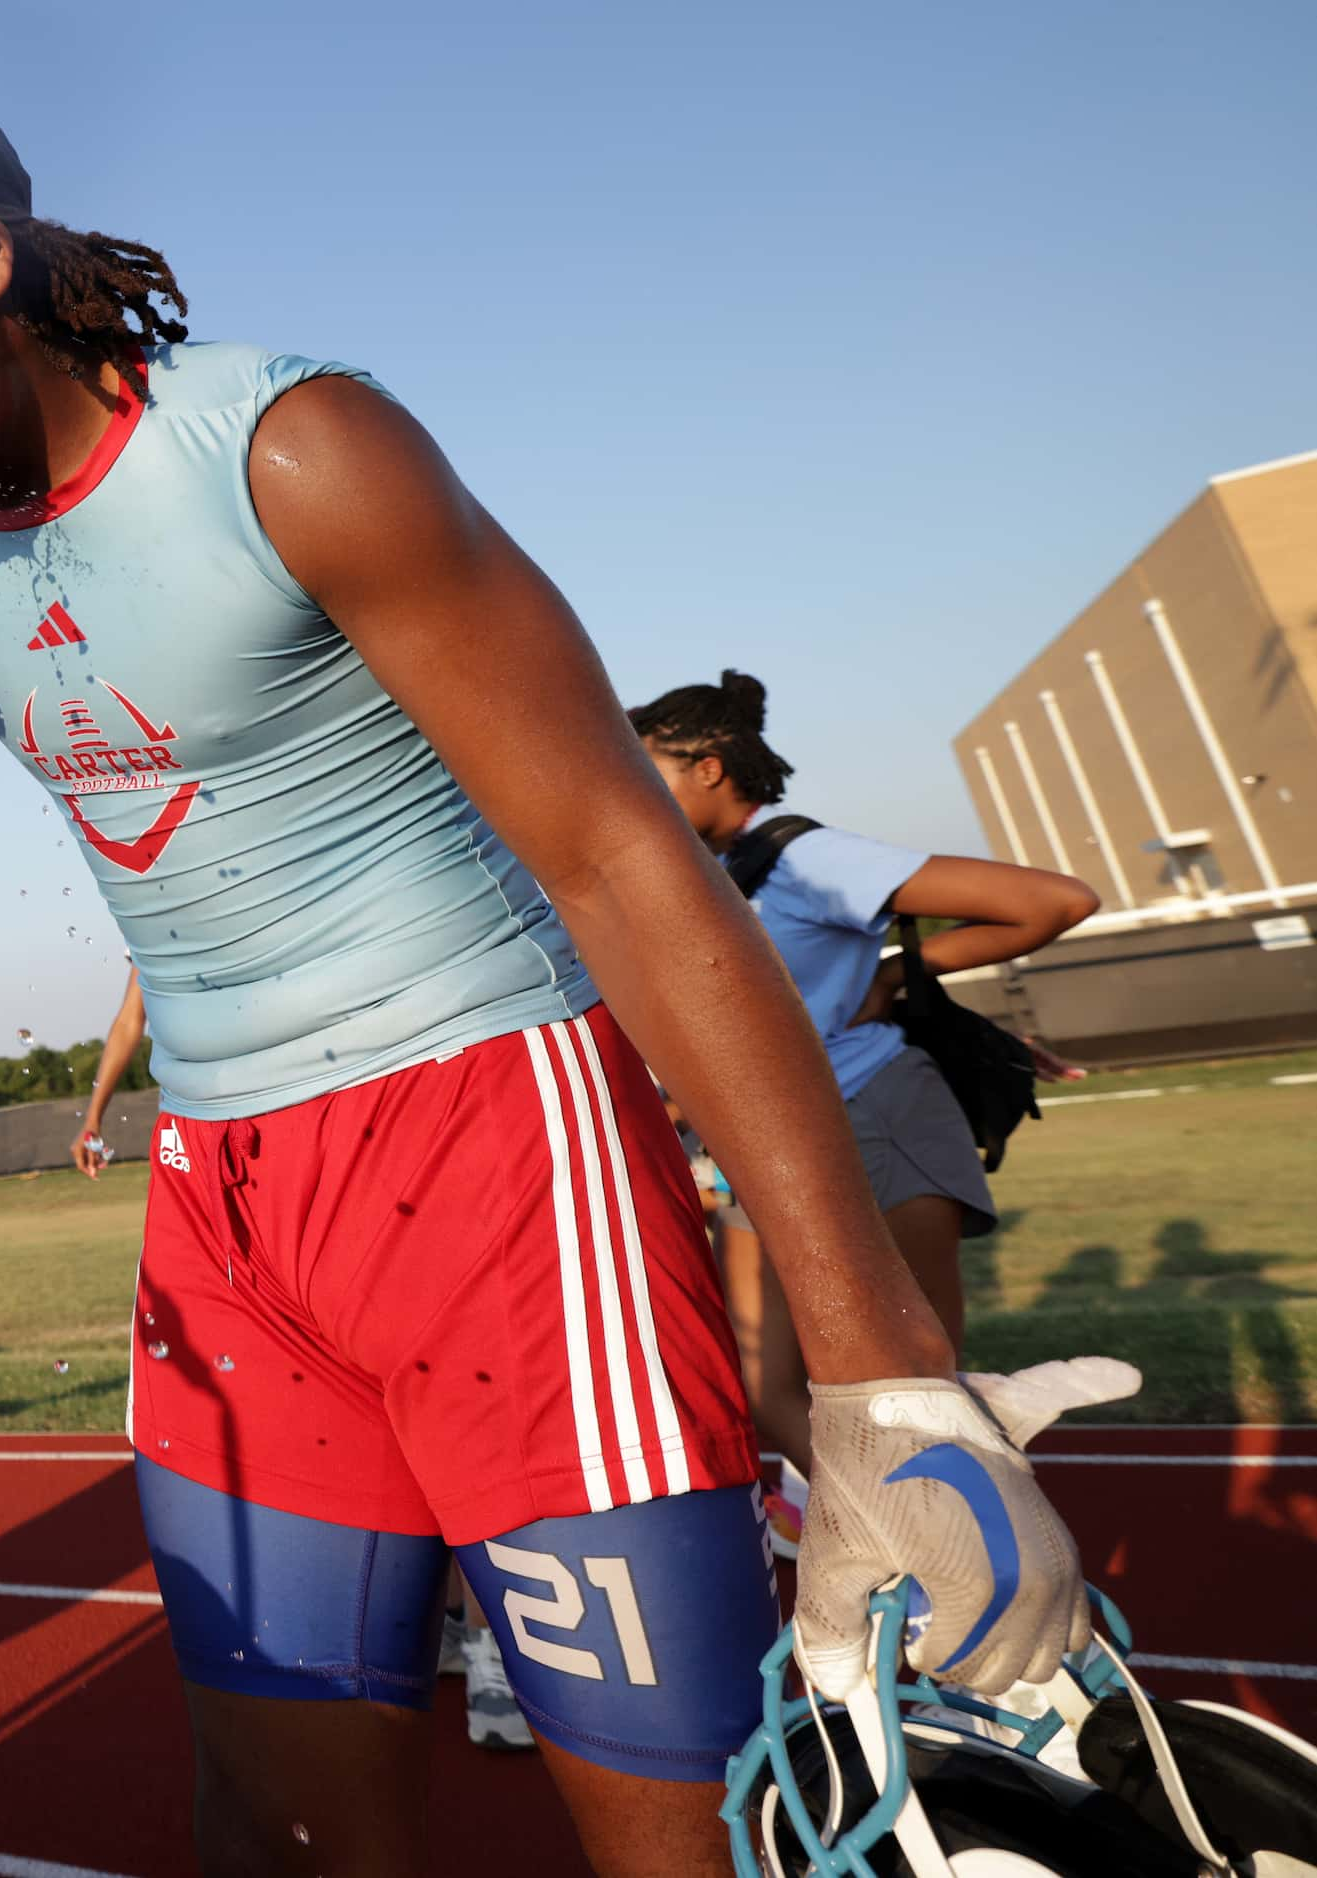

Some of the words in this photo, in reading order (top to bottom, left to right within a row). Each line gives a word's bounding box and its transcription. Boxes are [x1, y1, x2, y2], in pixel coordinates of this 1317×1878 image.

[33, 745, 183, 780] CARTER
[71, 773, 165, 794] FOOTBALL
[484, 1539, 659, 1687] 21
